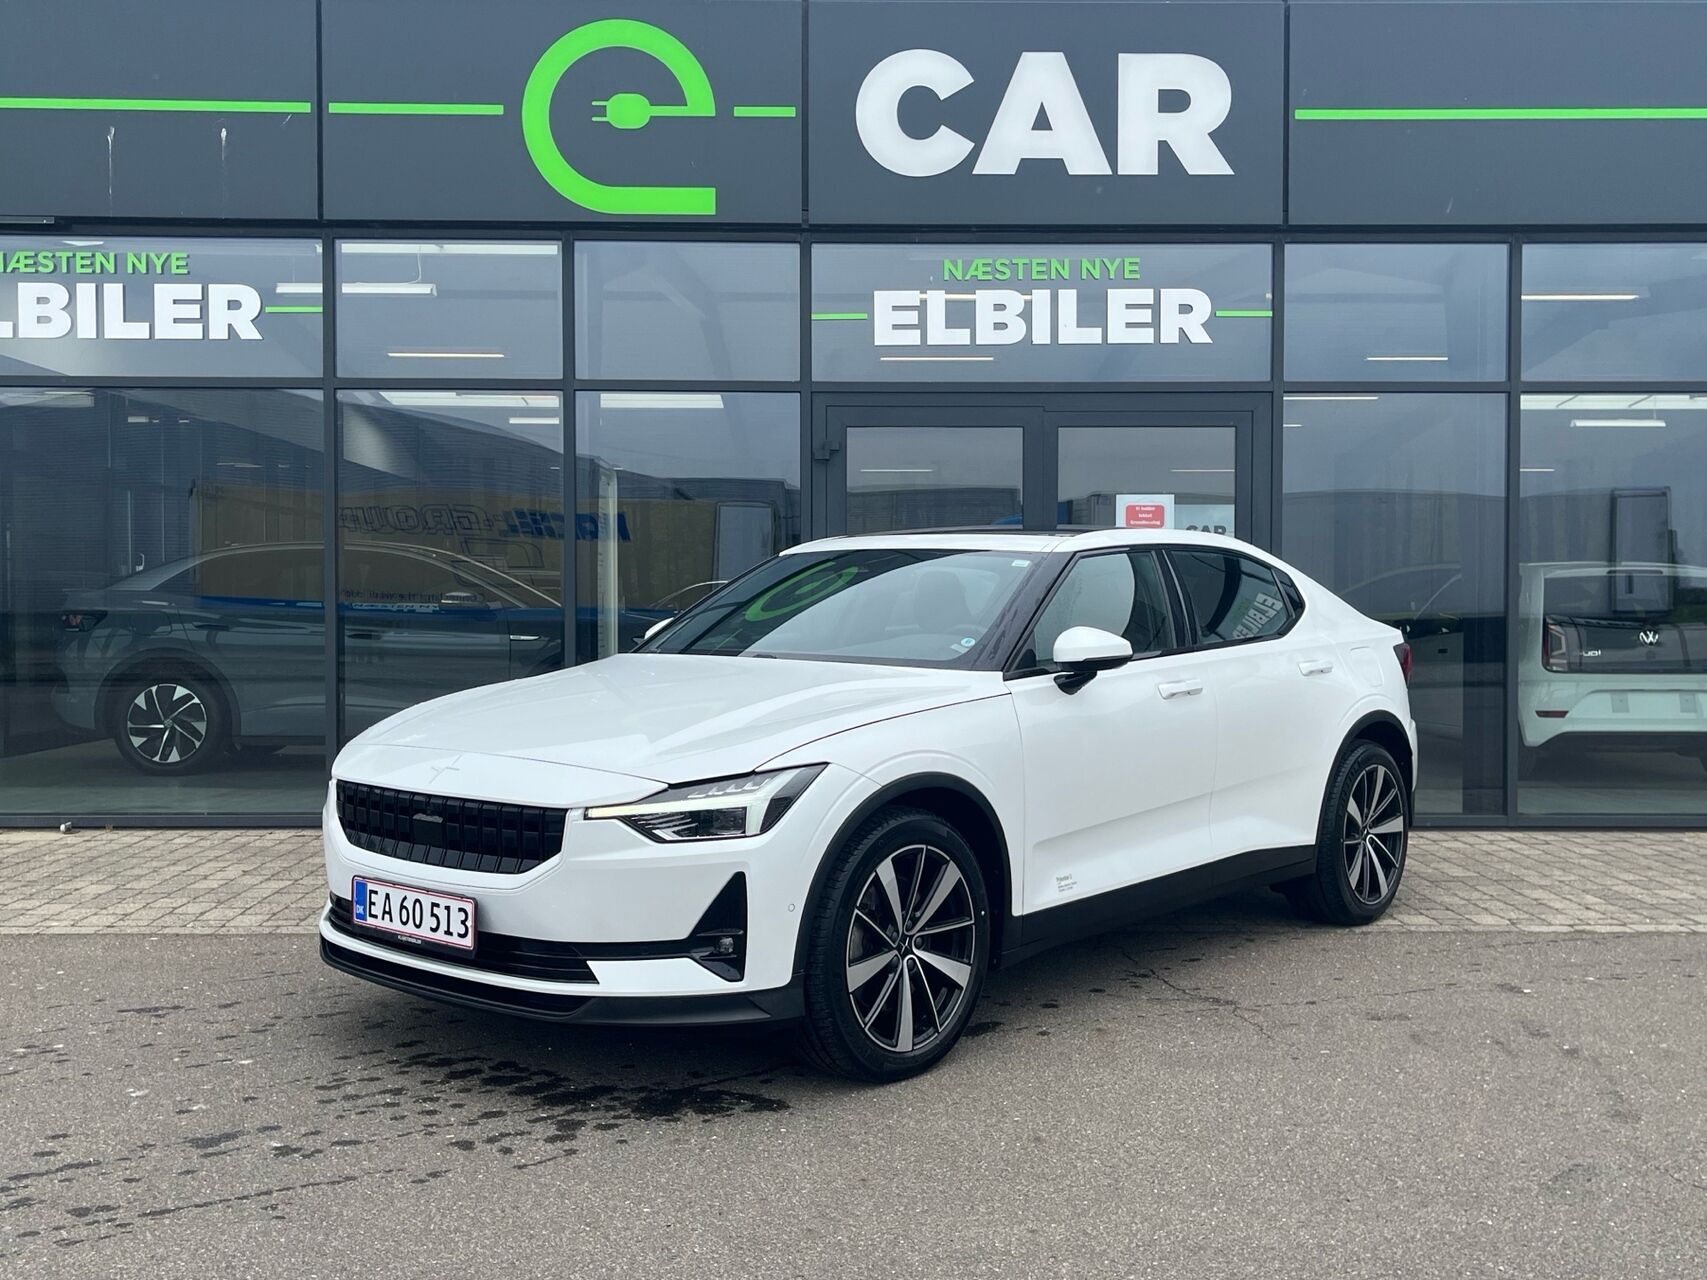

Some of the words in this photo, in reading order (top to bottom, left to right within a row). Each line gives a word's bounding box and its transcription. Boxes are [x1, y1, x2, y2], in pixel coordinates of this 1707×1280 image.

[855, 48, 1235, 178] CAR
[0, 250, 116, 274] ÆSTEN
[127, 252, 190, 275] NYE
[942, 257, 1071, 281] NÆSTEN
[1081, 257, 1141, 280] NYE
[0, 281, 265, 341] BILER
[873, 288, 1213, 346] ELBILER
[356, 904, 365, 915] DK
[368, 889, 393, 923] EA
[399, 895, 423, 929] 60
[430, 902, 469, 939] 513
